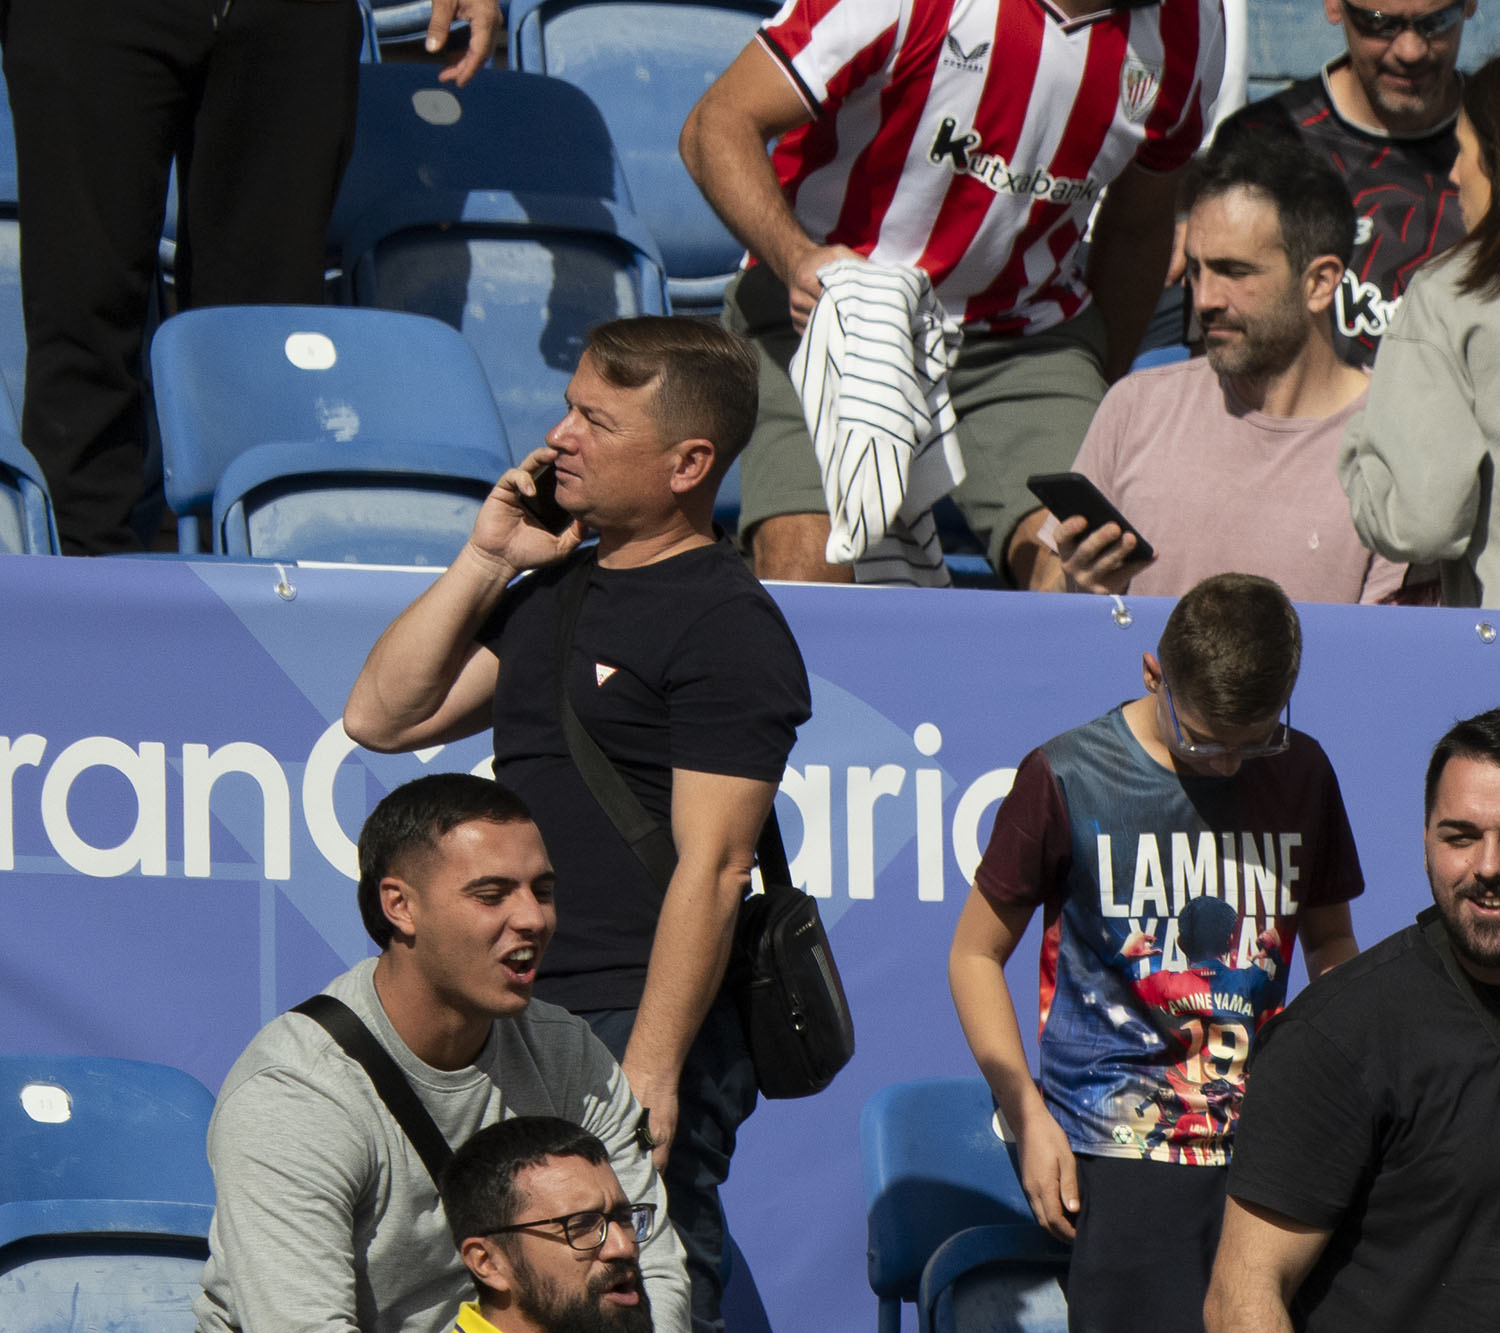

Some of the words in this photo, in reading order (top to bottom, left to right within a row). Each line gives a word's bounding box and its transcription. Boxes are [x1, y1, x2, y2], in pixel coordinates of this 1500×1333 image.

[929, 115, 1100, 203] Kutxabank
[1097, 831, 1302, 918] LAMINE
[1179, 1018, 1250, 1086] 19
